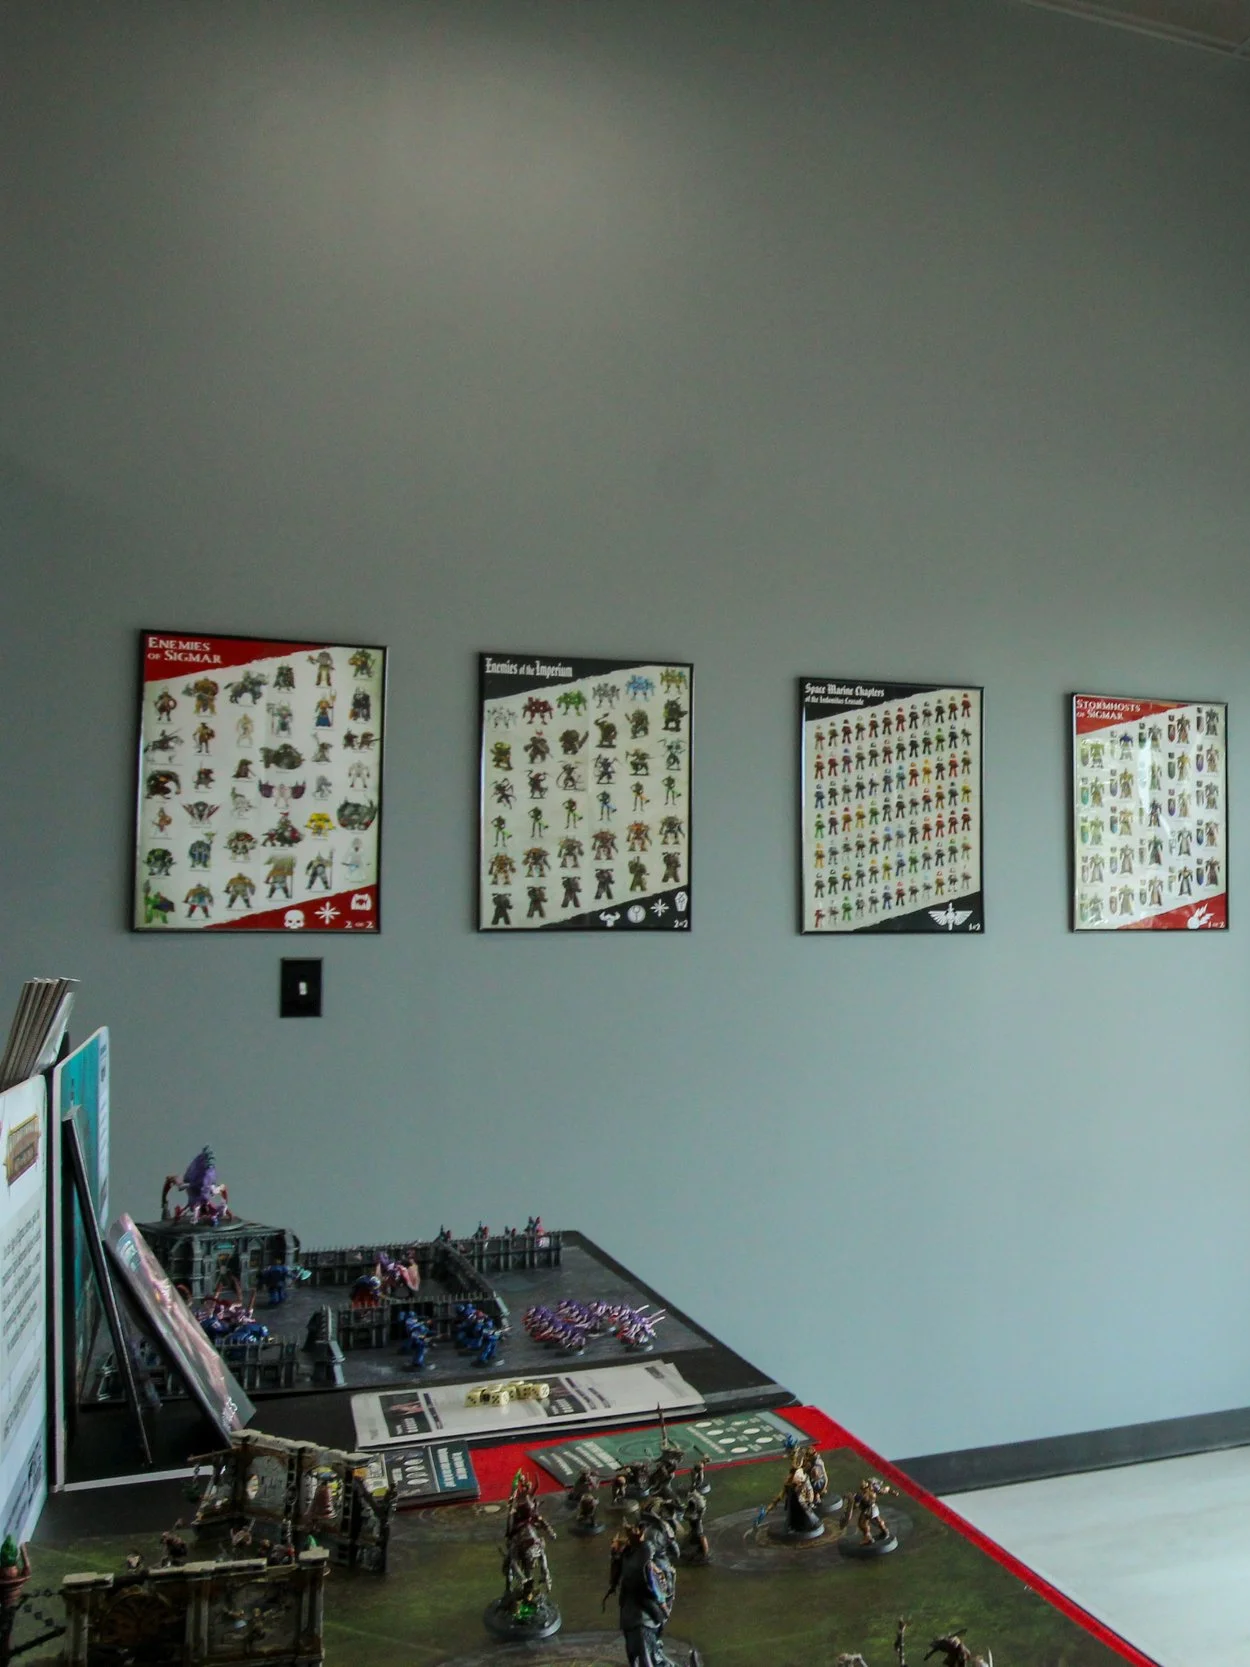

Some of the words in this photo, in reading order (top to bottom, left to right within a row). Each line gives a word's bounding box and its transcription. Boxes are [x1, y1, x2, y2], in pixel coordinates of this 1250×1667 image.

[148, 637, 211, 651] ENEMIES
[164, 649, 222, 664] SIGMAR
[484, 657, 518, 675] Enemies
[535, 660, 573, 679] Imperium
[804, 682, 826, 695] Space
[827, 683, 854, 696] Marine
[855, 685, 885, 698] Chapters
[1076, 699, 1141, 712] STORMHOSTS
[1086, 709, 1124, 720] SIGMAR
[344, 920, 353, 929] 2
[366, 920, 374, 929] 2
